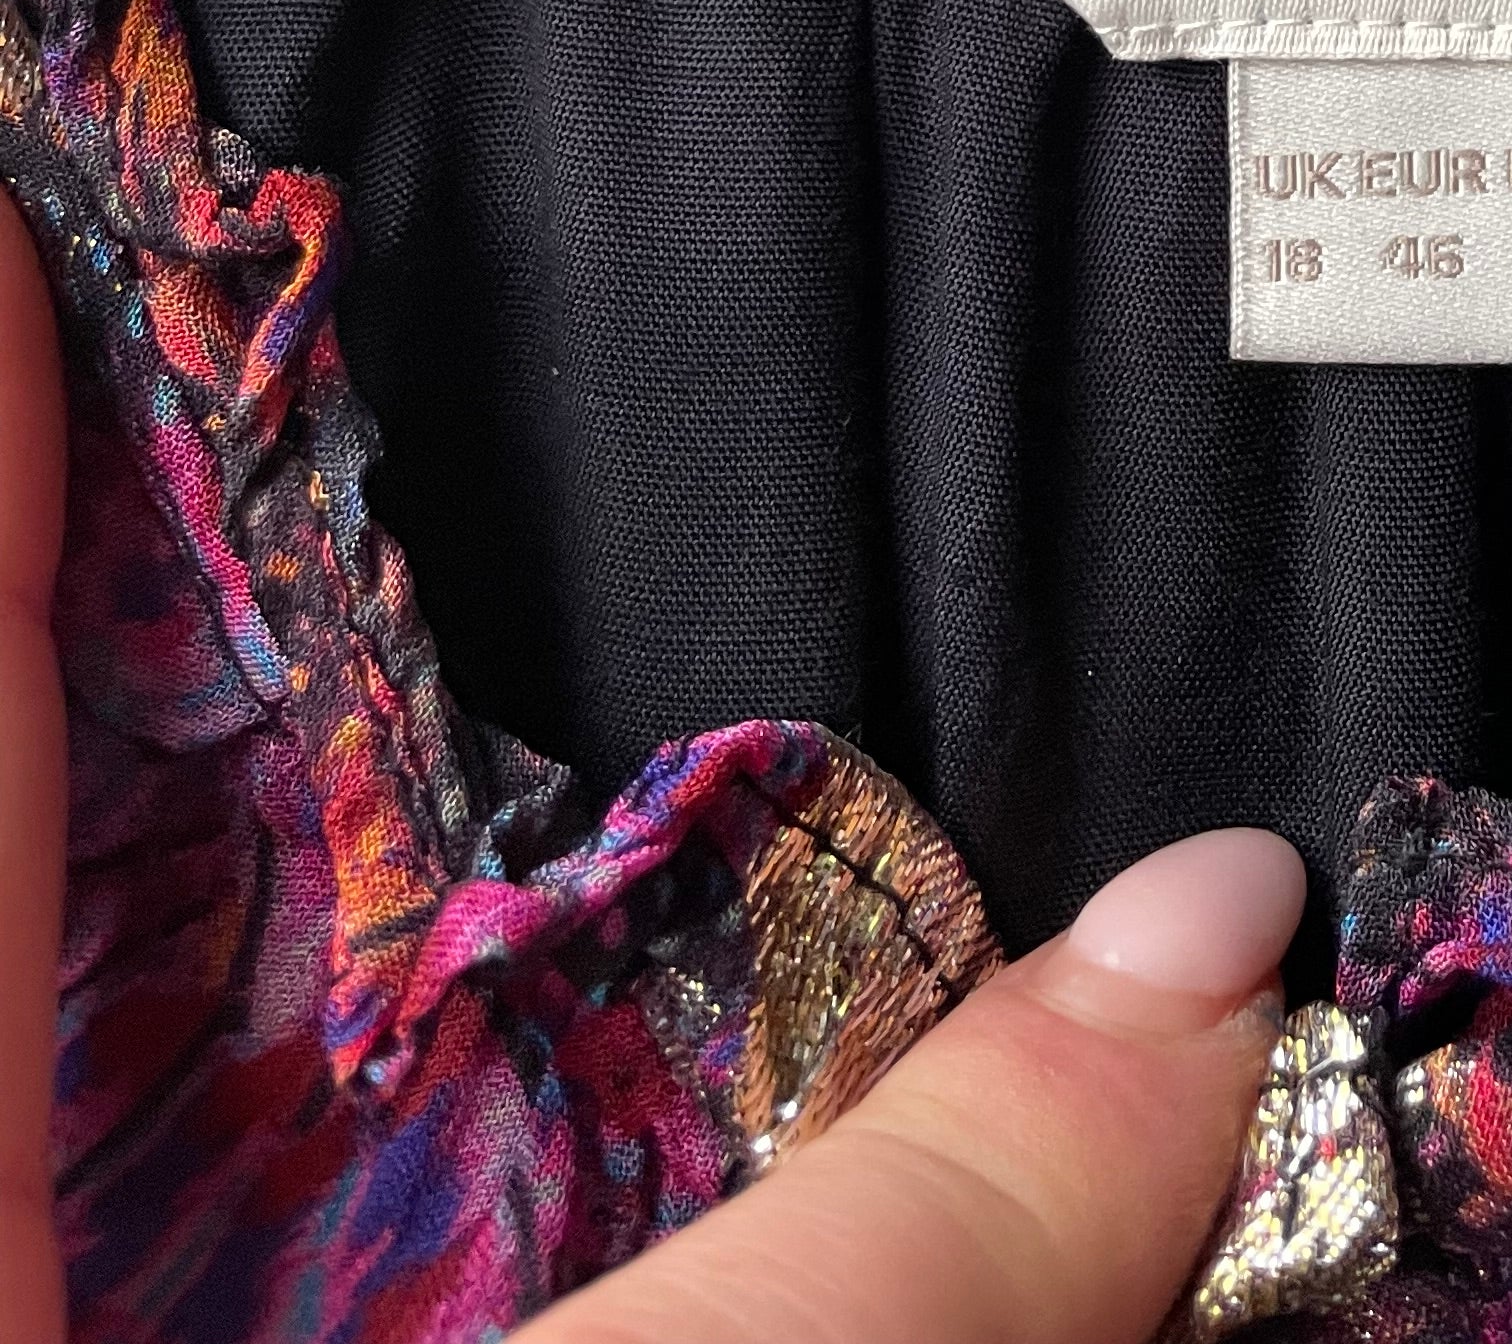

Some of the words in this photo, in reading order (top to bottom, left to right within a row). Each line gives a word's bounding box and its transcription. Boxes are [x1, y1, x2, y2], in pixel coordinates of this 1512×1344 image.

[1255, 149, 1347, 200] UK
[1361, 147, 1491, 198] EUR
[1264, 237, 1323, 284] 18
[1379, 233, 1465, 281] 46
